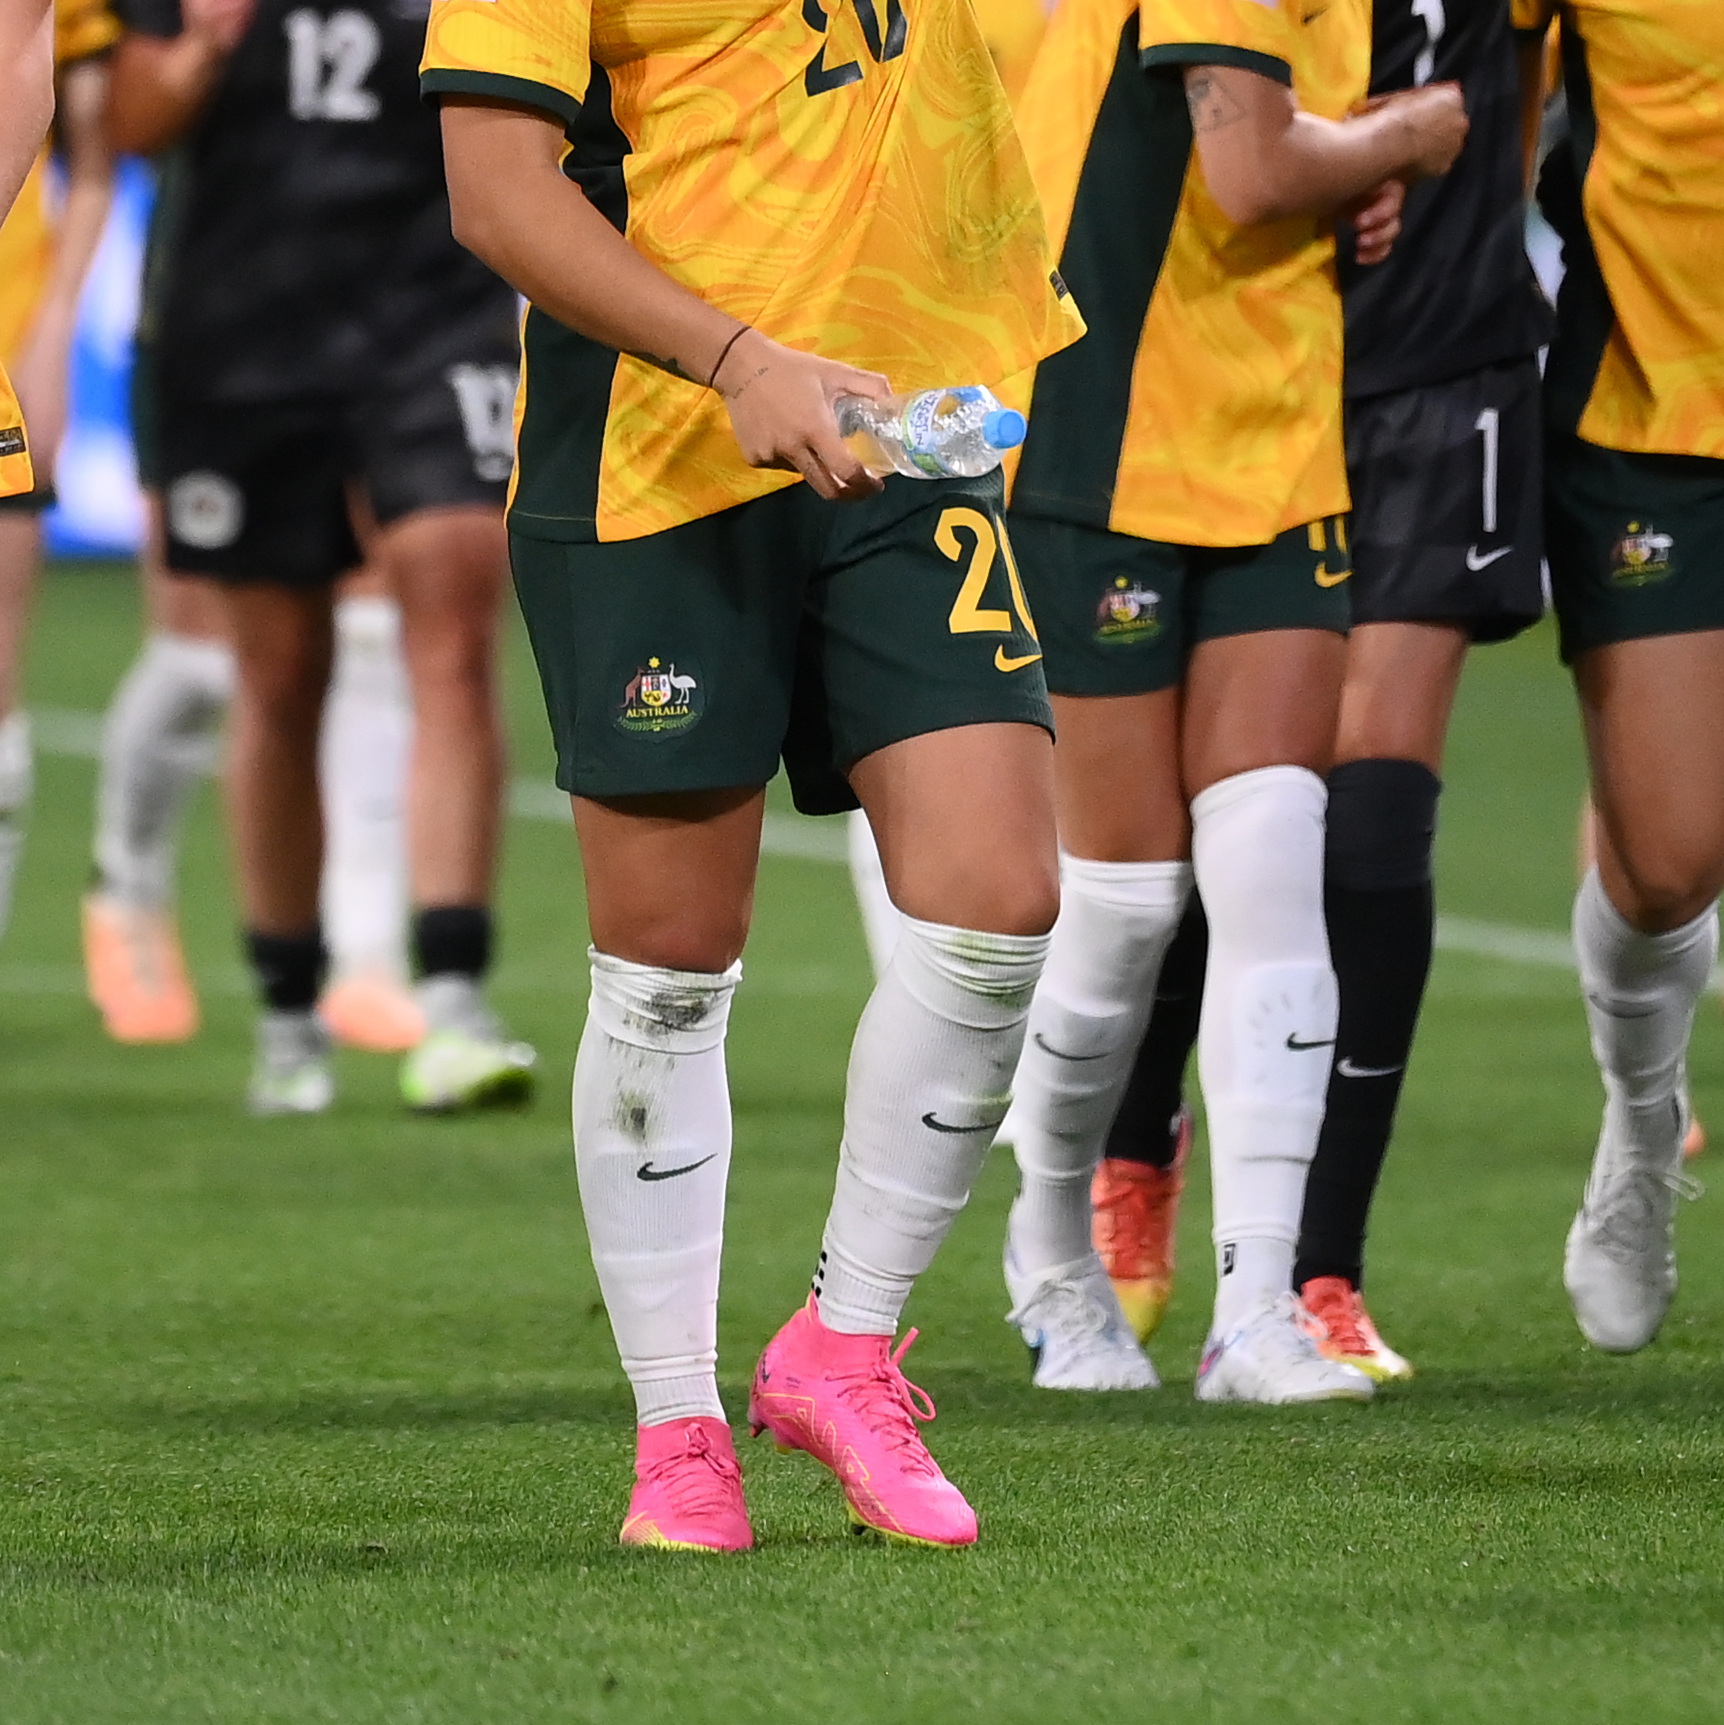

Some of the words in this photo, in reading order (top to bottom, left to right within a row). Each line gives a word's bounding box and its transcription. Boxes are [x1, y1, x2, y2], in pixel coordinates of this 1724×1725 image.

[284, 8, 383, 123] 12
[1474, 408, 1499, 533] 1
[626, 704, 690, 718] AUSTRALIA
